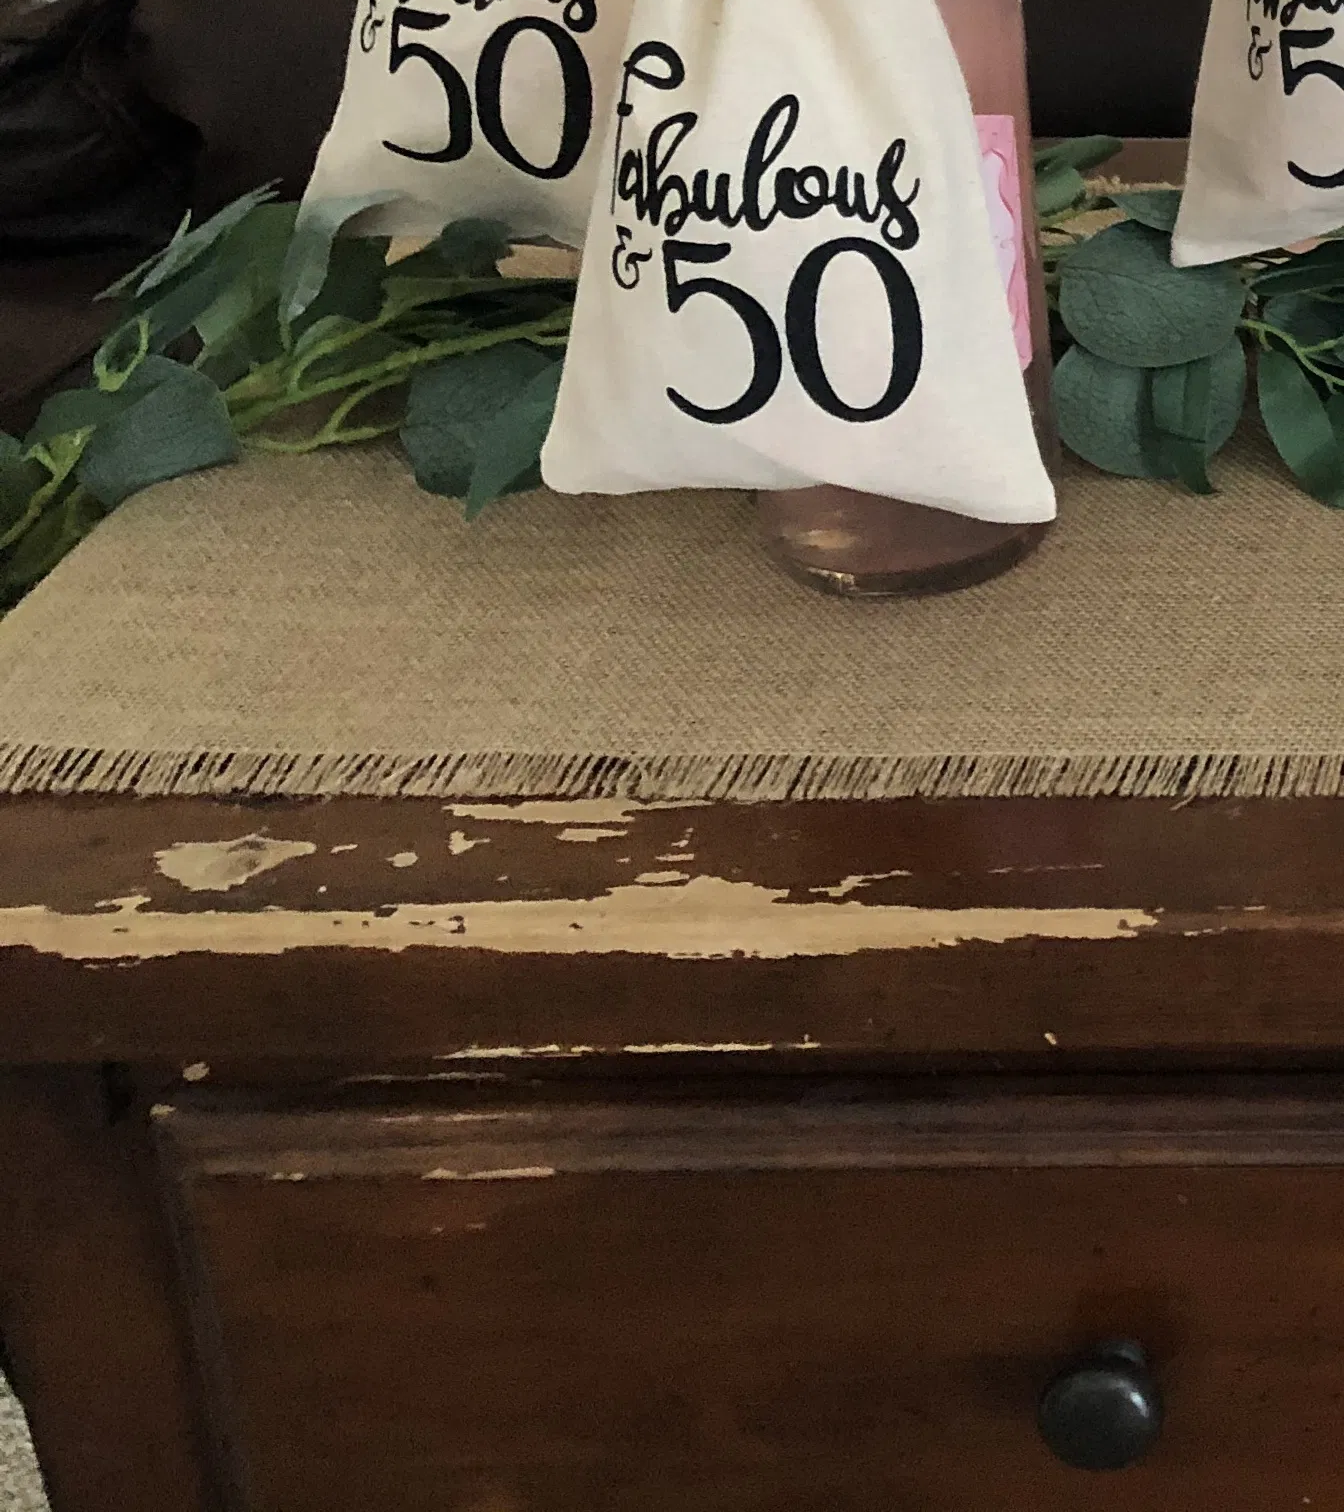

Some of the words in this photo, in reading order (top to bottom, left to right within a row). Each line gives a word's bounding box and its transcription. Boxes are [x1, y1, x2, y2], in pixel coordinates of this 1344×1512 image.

[381, 6, 594, 181] 50
[1247, 25, 1272, 81] &
[612, 225, 653, 290] &
[661, 236, 923, 426] 50
